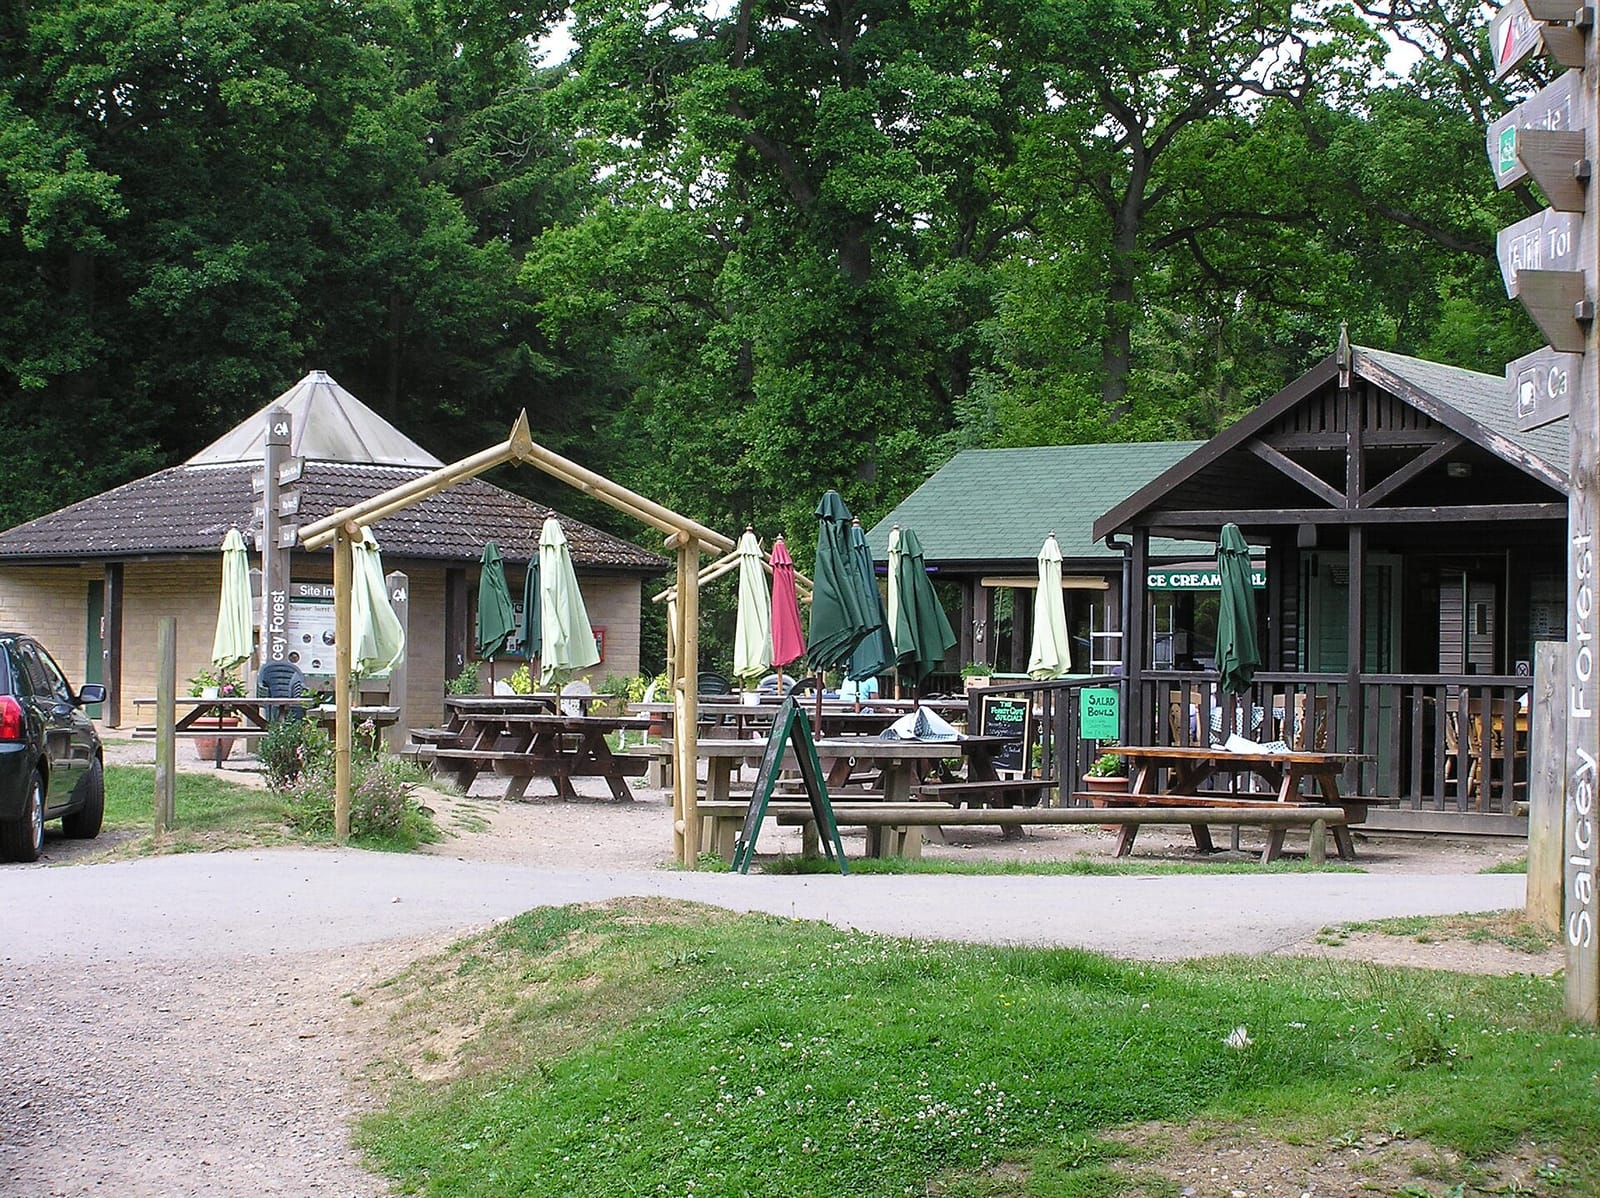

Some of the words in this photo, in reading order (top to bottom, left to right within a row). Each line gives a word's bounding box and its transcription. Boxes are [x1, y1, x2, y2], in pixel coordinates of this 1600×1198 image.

[300, 585, 321, 596] Site
[1147, 574, 1167, 587] CE
[1169, 573, 1222, 587] CREAM
[269, 590, 285, 633] Forest
[1572, 531, 1592, 718] Forest
[272, 636, 287, 661] cey
[1088, 694, 1115, 706] SALAD
[1569, 747, 1597, 948] Salcey
